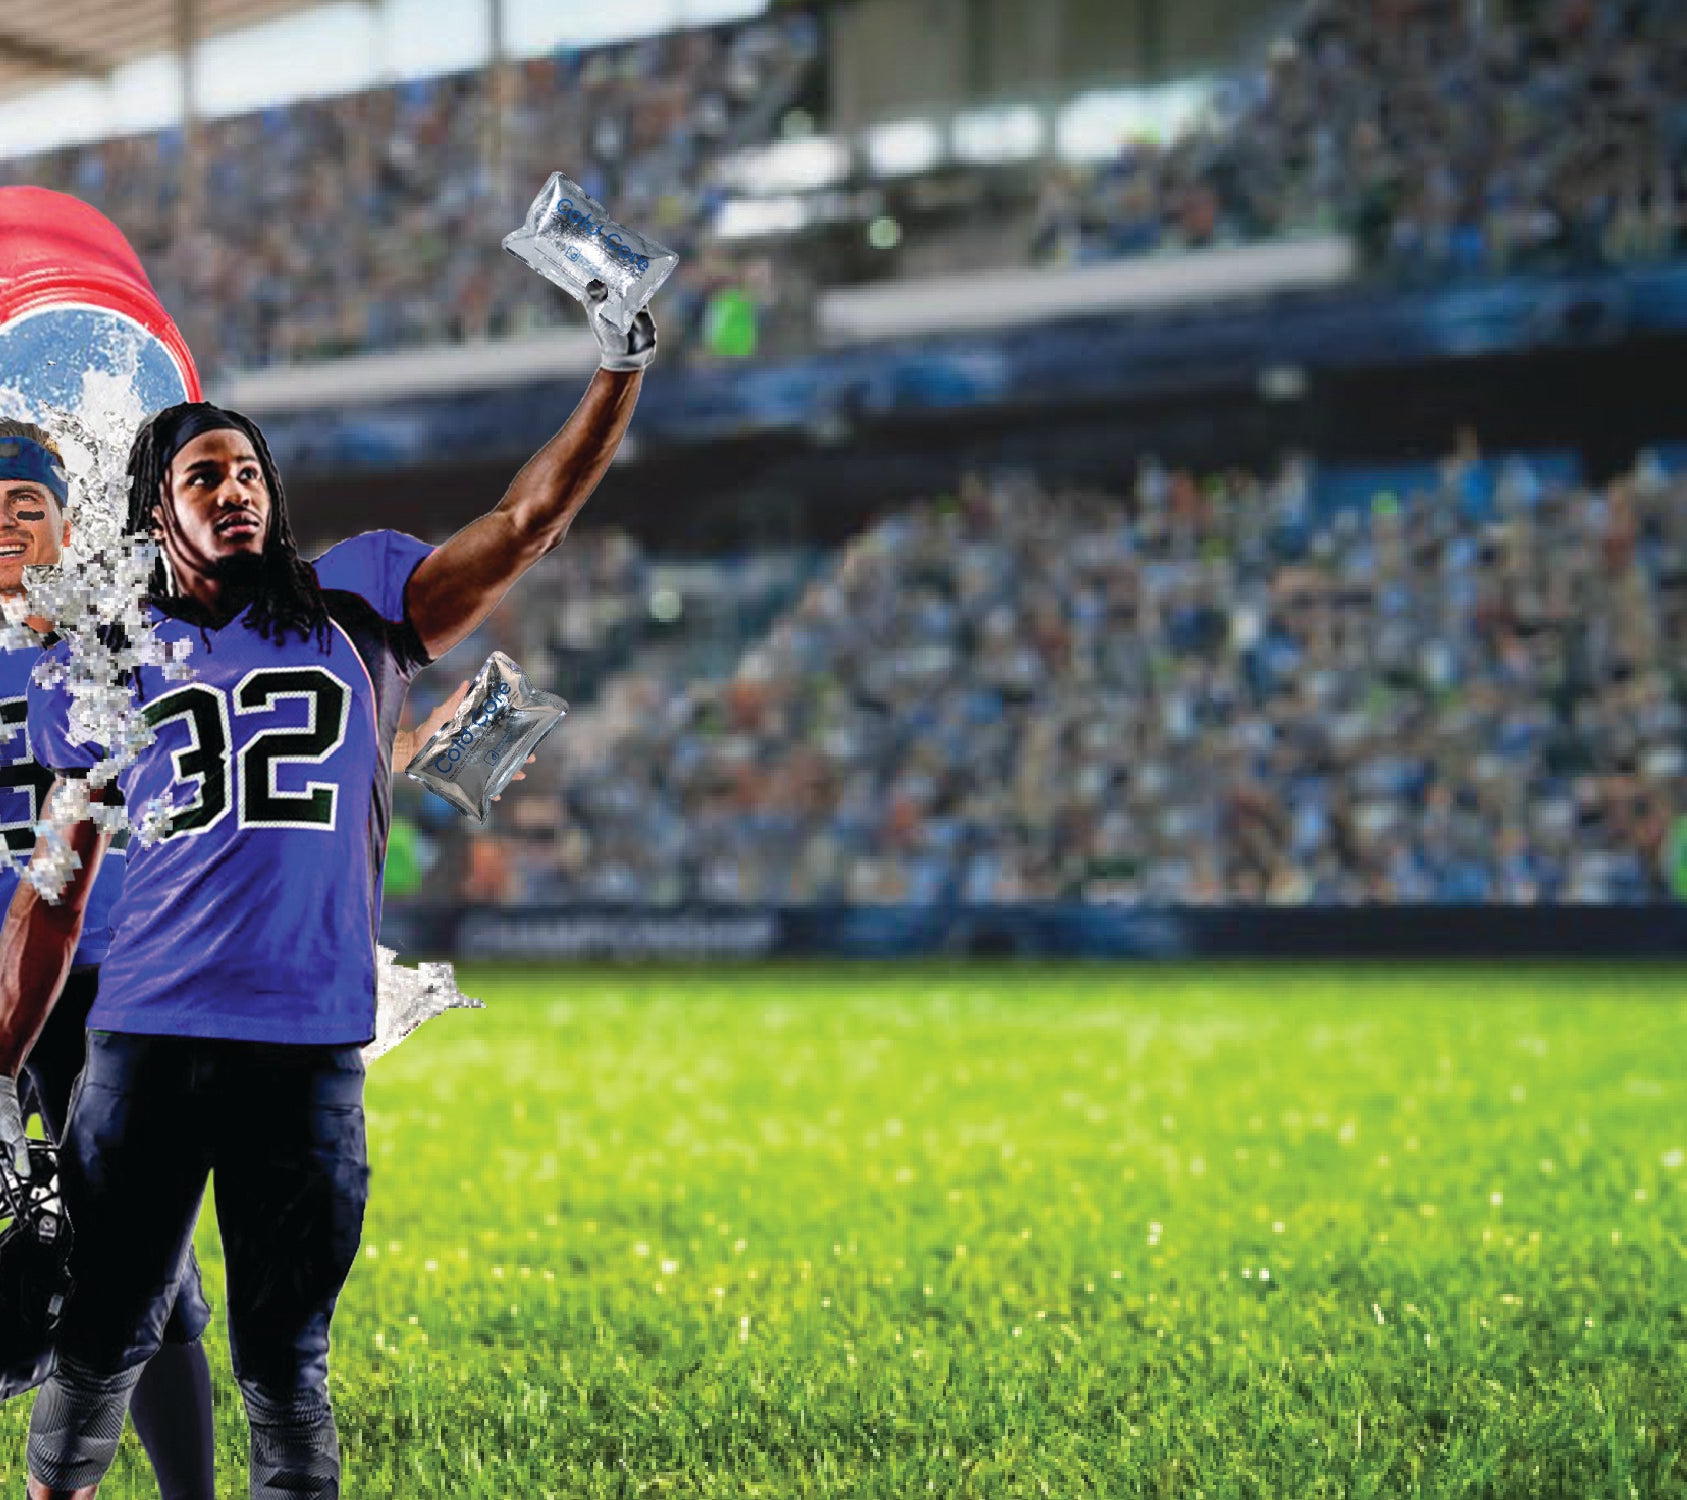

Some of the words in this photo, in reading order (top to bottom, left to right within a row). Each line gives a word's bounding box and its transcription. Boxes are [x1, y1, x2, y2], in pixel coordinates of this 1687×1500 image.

[557, 199, 604, 236] Cold
[606, 233, 650, 272] Core
[141, 665, 352, 844] 32
[434, 726, 474, 774] Cold
[472, 682, 511, 727] Core
